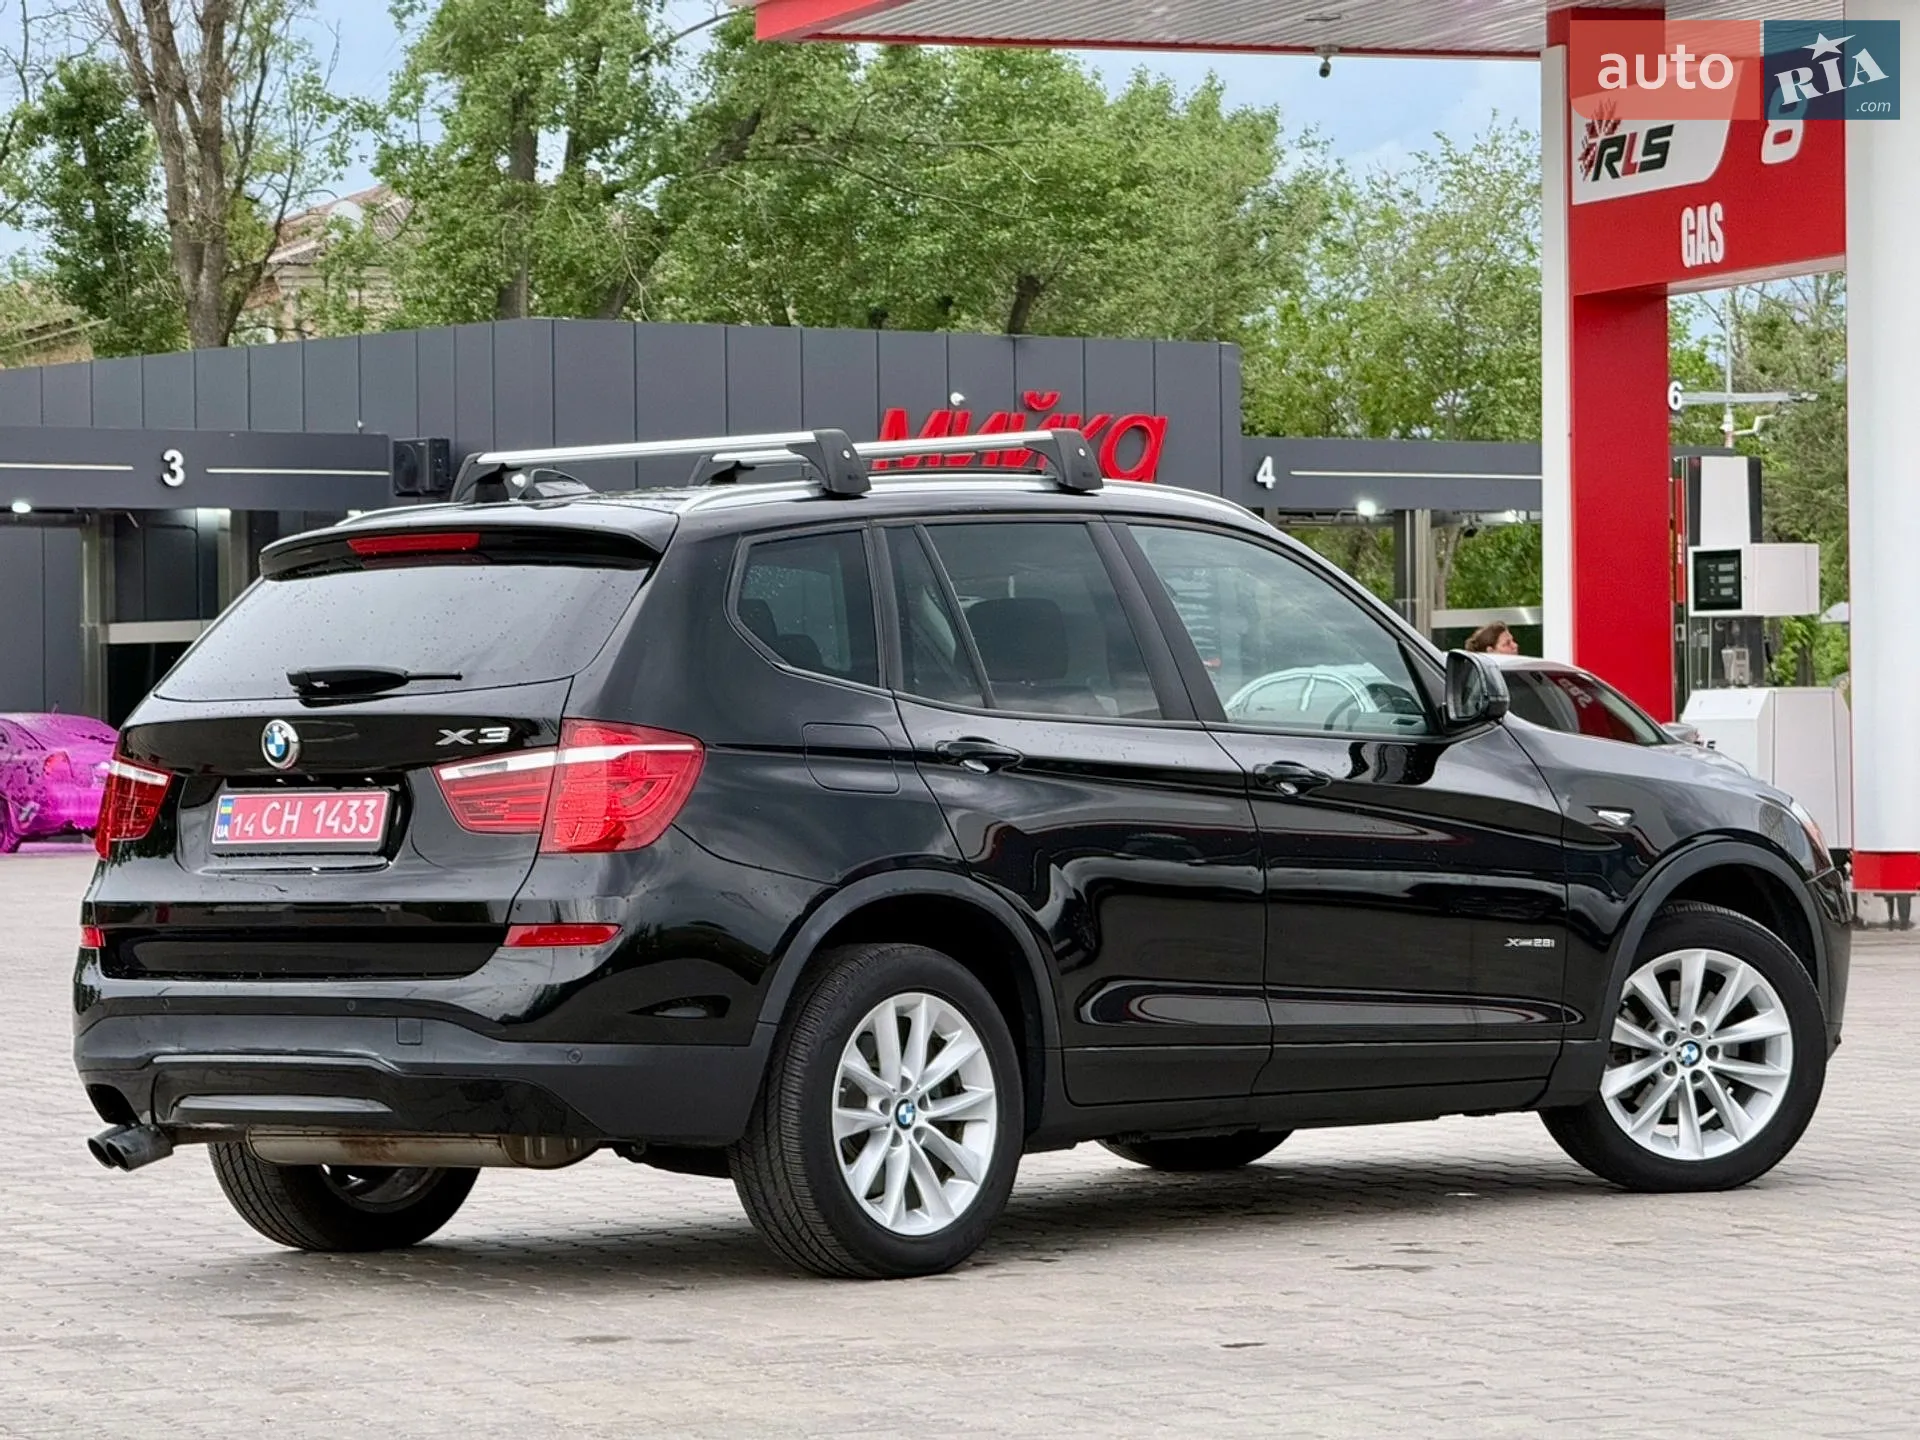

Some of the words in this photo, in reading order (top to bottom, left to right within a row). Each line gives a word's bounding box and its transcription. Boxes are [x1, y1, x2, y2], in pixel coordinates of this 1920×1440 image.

[1761, 83, 1807, 165] 8
[1590, 123, 1675, 182] RLS
[1681, 202, 1725, 269] GAS
[1668, 380, 1684, 411] 6
[162, 448, 185, 487] 3
[1256, 455, 1276, 490] 4
[435, 727, 511, 746] X3
[216, 824, 229, 838] UA
[233, 813, 257, 837] 14
[312, 799, 378, 835] 1433
